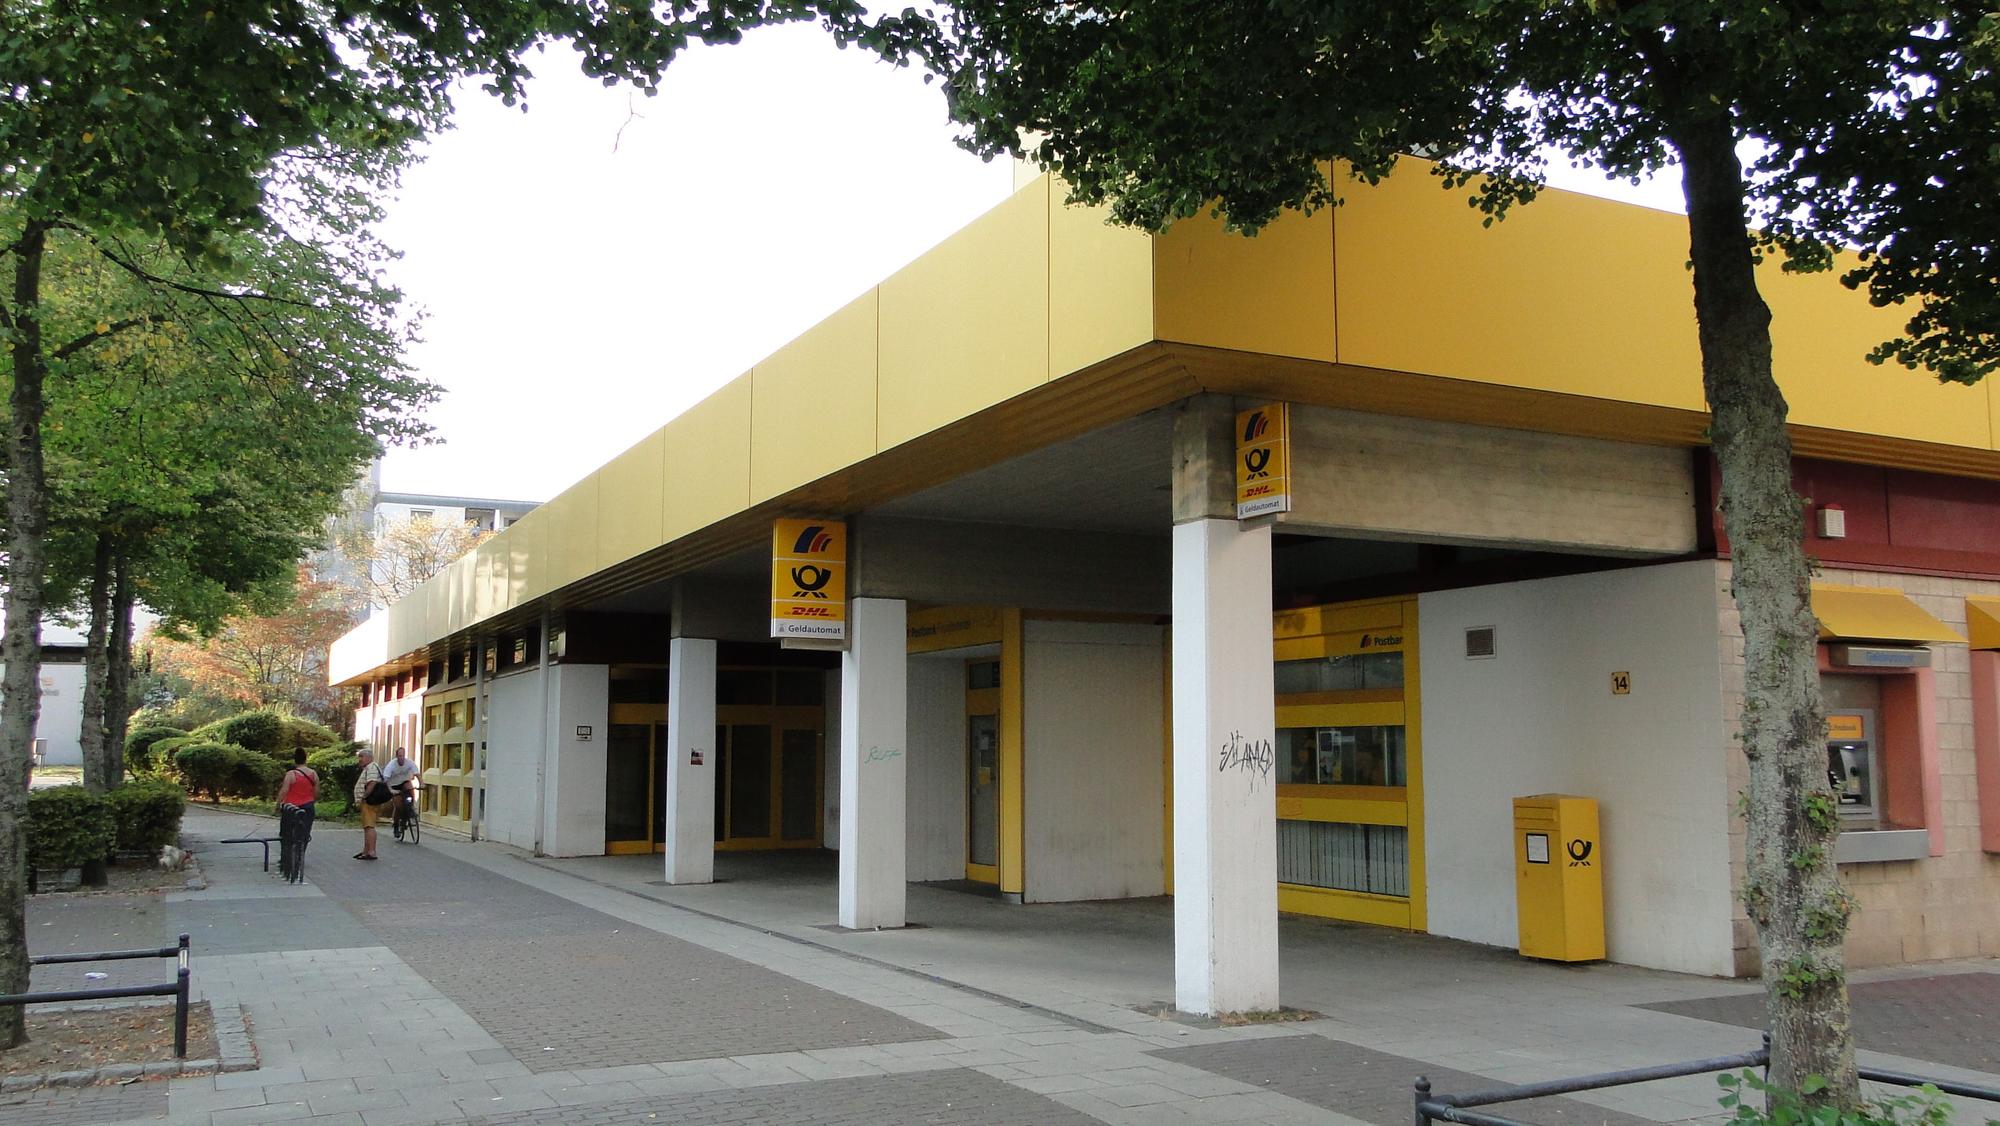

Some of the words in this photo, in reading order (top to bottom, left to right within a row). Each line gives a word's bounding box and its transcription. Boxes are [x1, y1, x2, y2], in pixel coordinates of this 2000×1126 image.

[1246, 485, 1271, 497] DHL
[1245, 500, 1280, 513] Geldautomat
[791, 606, 830, 616] DHL
[788, 624, 841, 634] Geldautomat
[1613, 676, 1628, 690] 14
